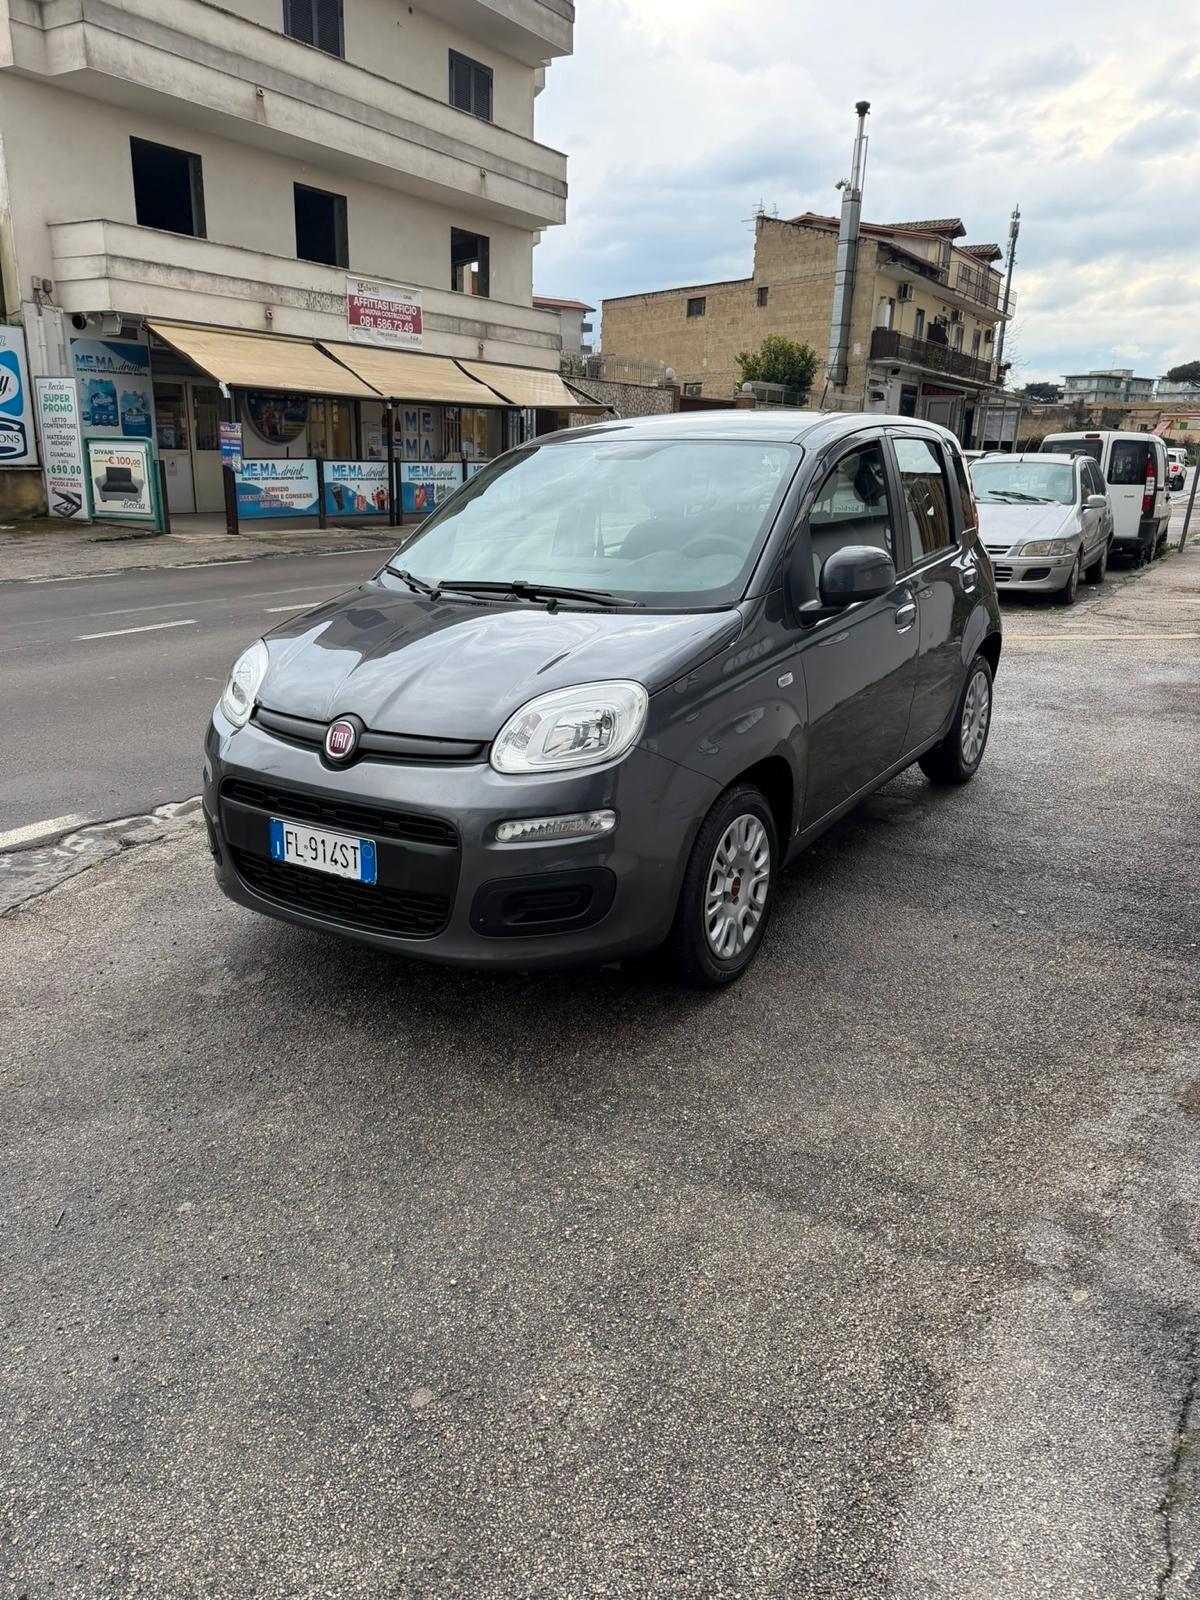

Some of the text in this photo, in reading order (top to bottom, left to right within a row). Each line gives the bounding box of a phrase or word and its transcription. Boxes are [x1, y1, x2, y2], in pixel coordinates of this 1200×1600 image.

[353, 297, 417, 315] AFFITTASI UFFICIO
[365, 308, 381, 316] NUOVA
[43, 393, 70, 402] SUPER
[43, 403, 73, 412] PROMO
[331, 730, 350, 749] FIAT
